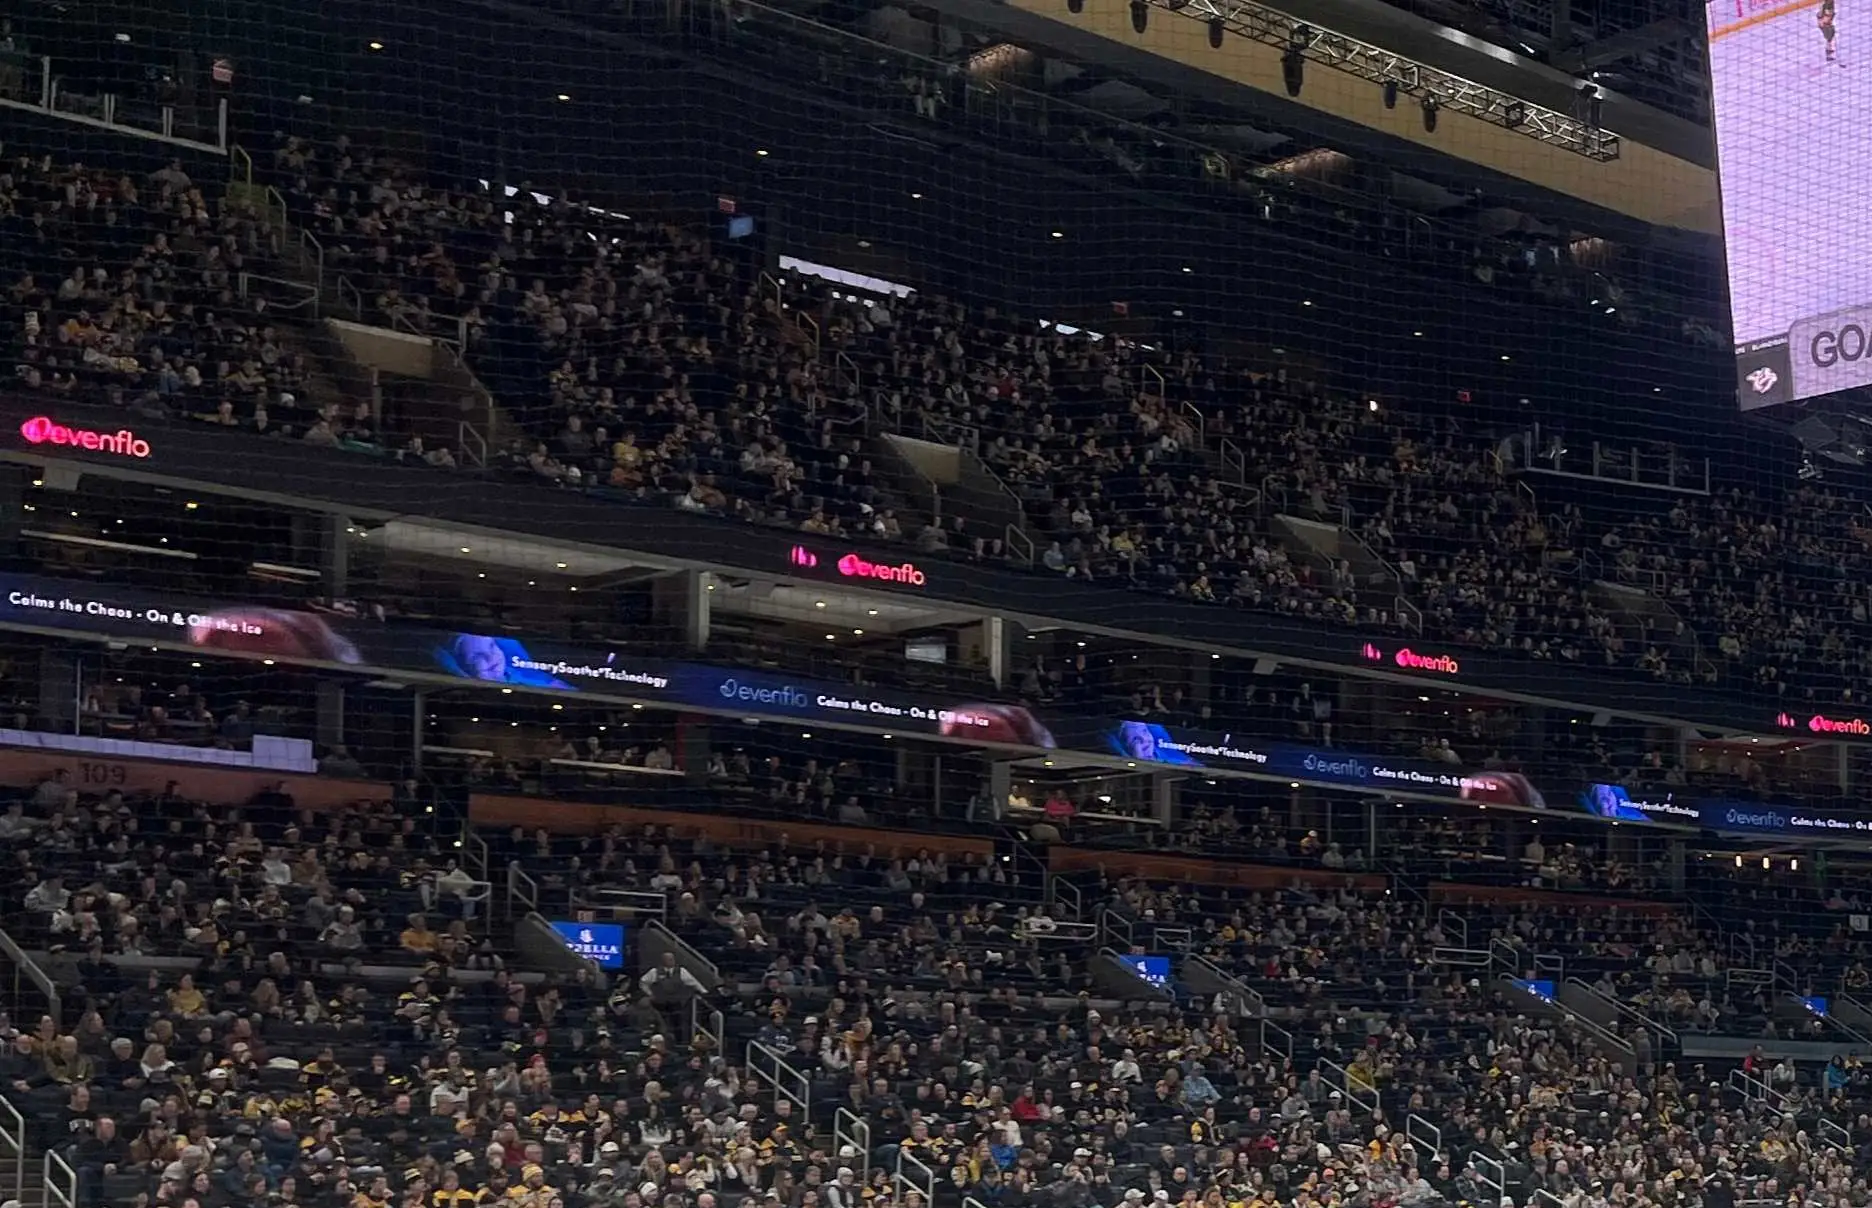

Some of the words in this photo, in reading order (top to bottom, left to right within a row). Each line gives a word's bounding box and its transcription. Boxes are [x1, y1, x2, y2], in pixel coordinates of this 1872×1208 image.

[49, 426, 151, 458] evenflo
[858, 561, 926, 586] evenflo
[9, 592, 54, 609] Calms
[59, 598, 82, 613] the
[86, 601, 132, 619] Chaos
[147, 609, 169, 625] On
[172, 612, 185, 626] &
[241, 621, 263, 636] Ice
[1410, 653, 1458, 674] evenflo
[738, 683, 808, 708] evenflo
[851, 699, 867, 712] the
[911, 707, 926, 719] On
[1824, 717, 1870, 735] evenflo
[79, 762, 126, 785] 109
[1316, 757, 1367, 778] evenflo
[1737, 809, 1785, 828] evenflo
